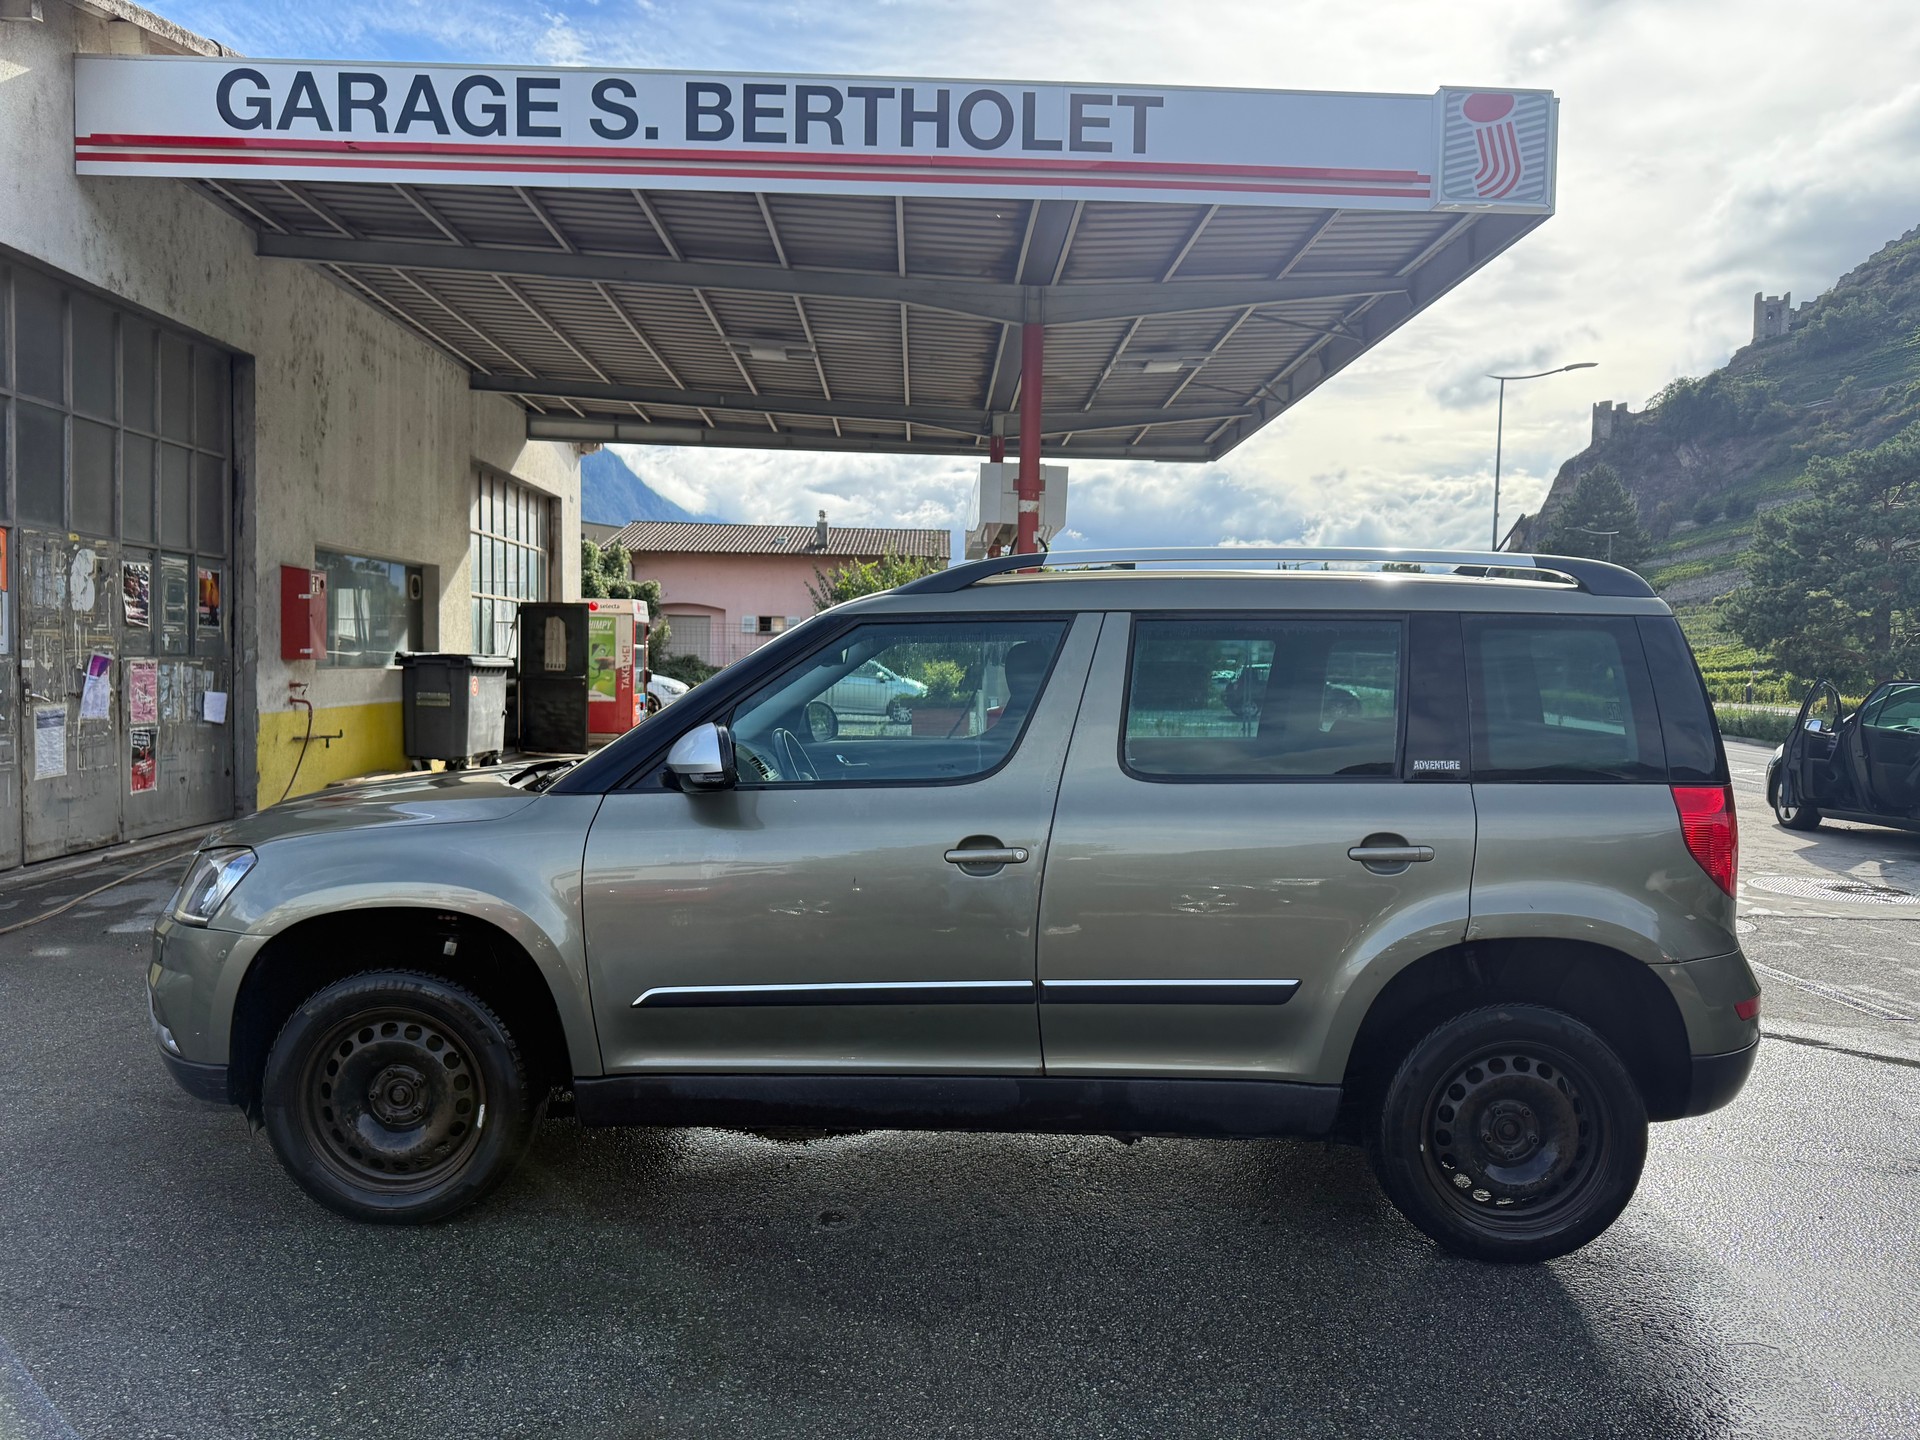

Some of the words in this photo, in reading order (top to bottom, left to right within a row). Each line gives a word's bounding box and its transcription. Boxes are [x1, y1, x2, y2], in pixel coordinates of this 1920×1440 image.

[216, 67, 562, 138] GARAGE
[589, 77, 659, 141] S.
[685, 81, 1164, 154] BERTHOLET
[589, 619, 613, 630] HIMPY
[621, 664, 630, 691] TAKE
[1413, 760, 1461, 770] ADVENTURE
